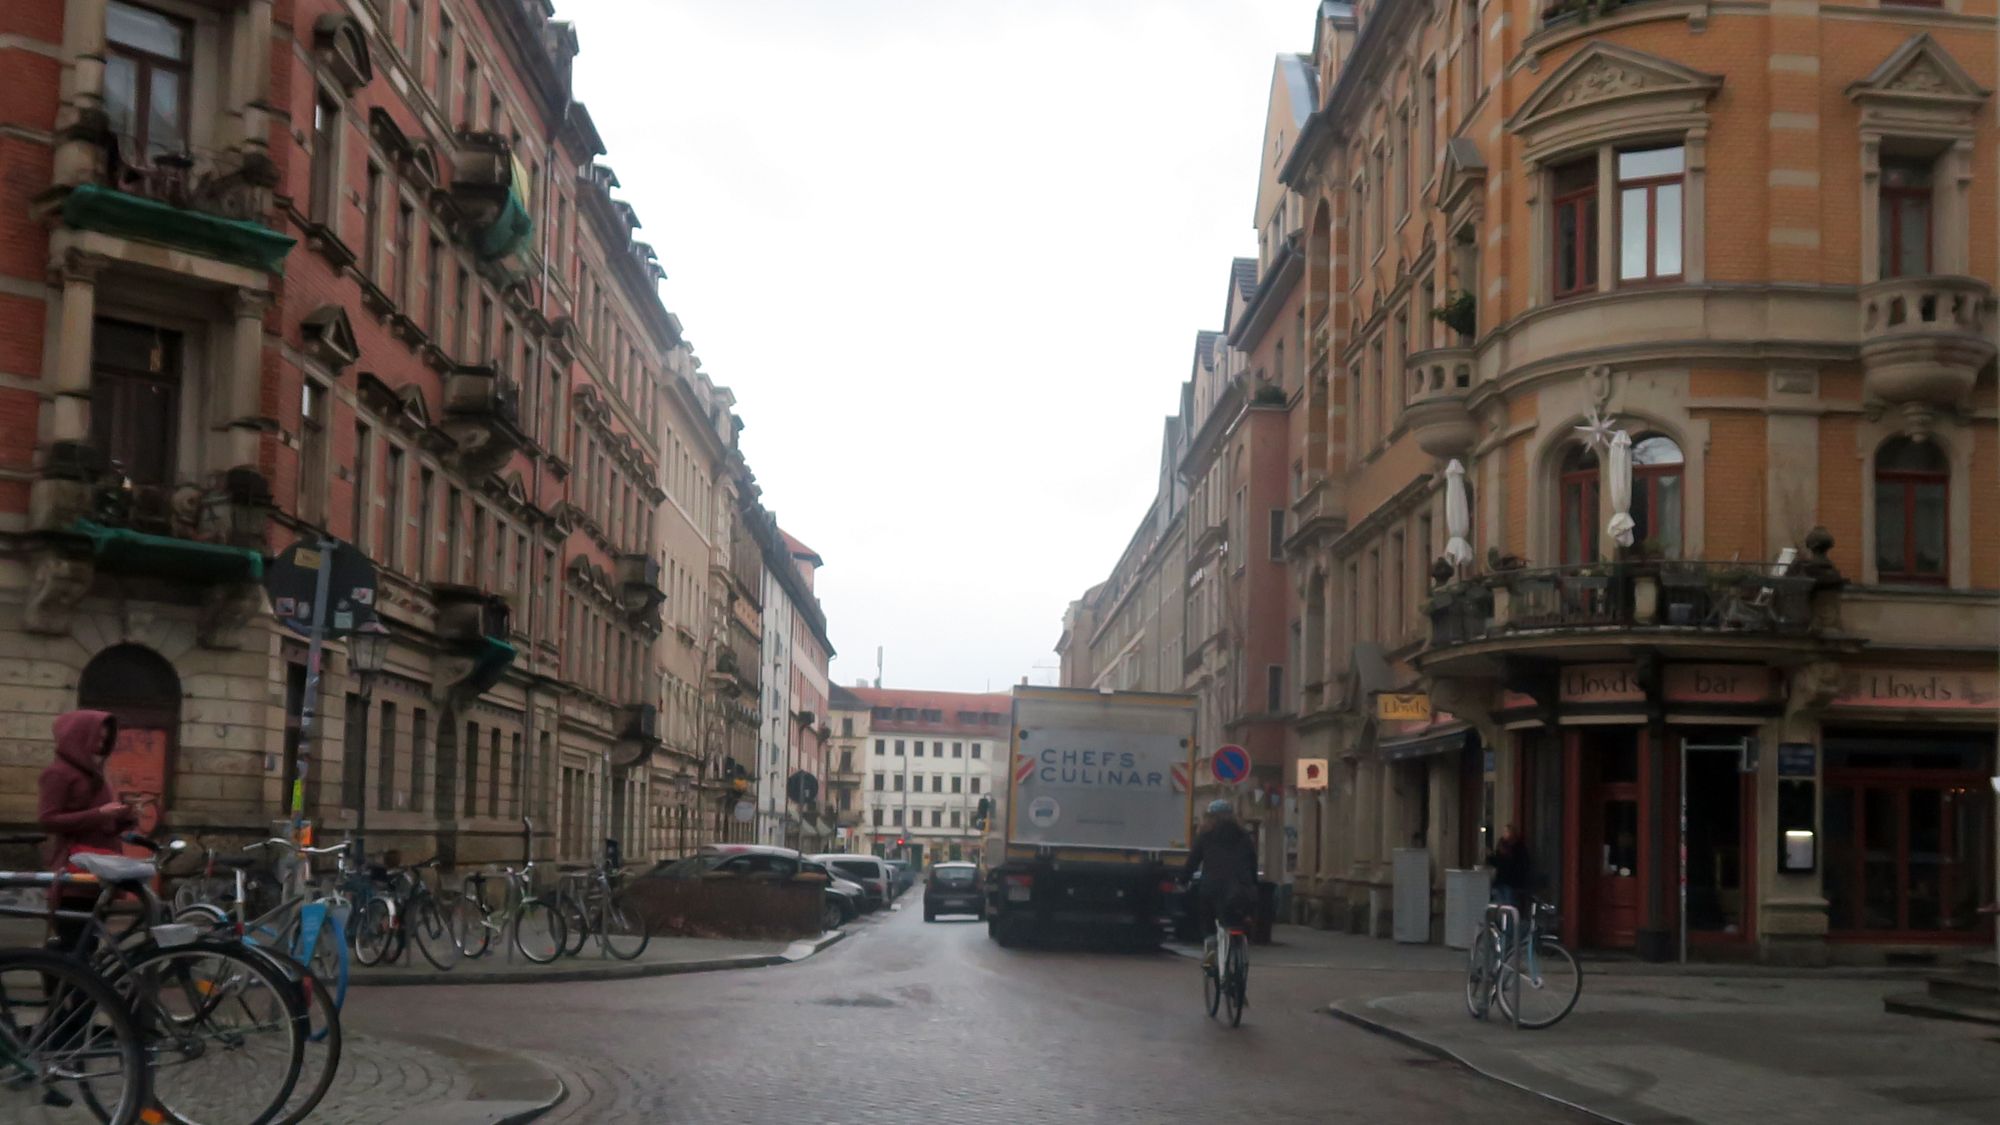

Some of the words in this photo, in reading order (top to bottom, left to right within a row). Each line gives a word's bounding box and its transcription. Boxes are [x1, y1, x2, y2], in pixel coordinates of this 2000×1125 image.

[1695, 670, 1740, 695] bar
[1040, 749, 1135, 768] CHEFS
[1040, 767, 1163, 786] CULINAR
